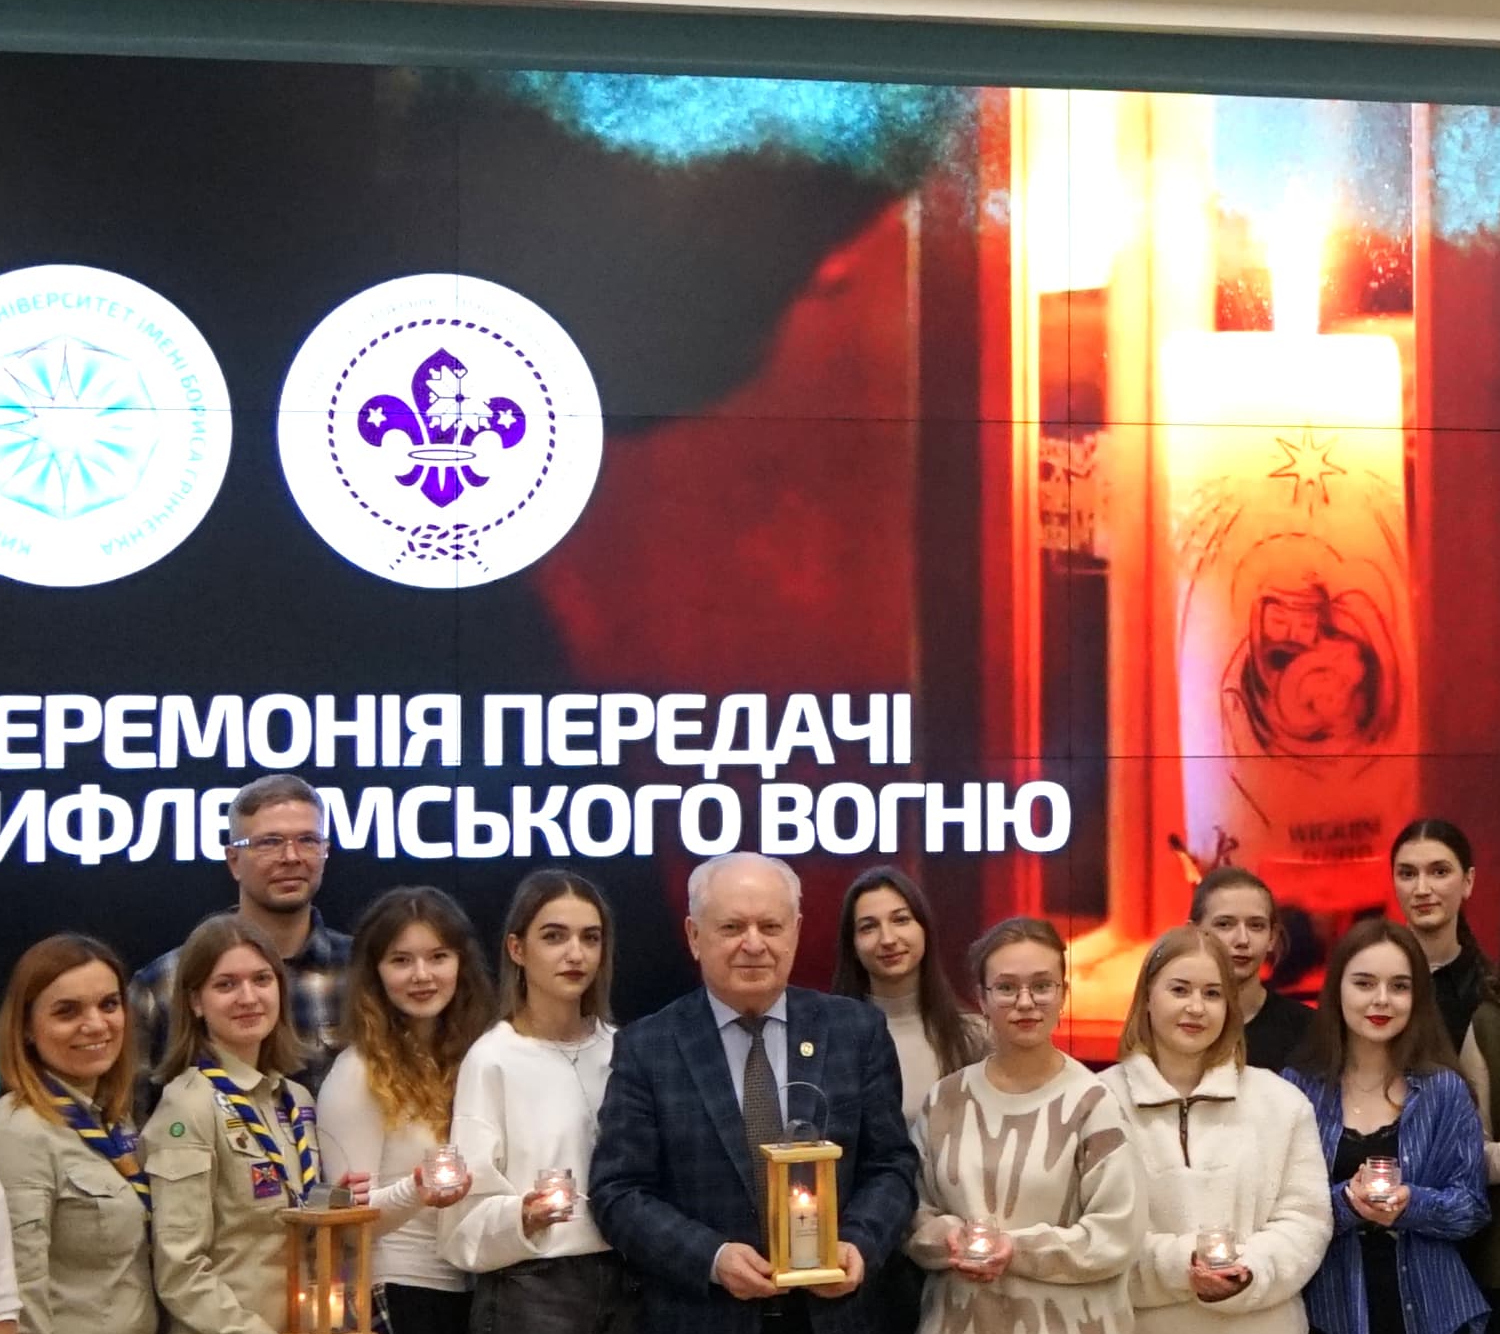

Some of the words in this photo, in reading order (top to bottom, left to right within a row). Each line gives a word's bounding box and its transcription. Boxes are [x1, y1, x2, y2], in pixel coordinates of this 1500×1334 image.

[136, 316, 190, 372] ІМЕНІ
[483, 693, 912, 780] ПЕРЕДАЧІ
[761, 780, 1072, 855] ВОГНЮ
